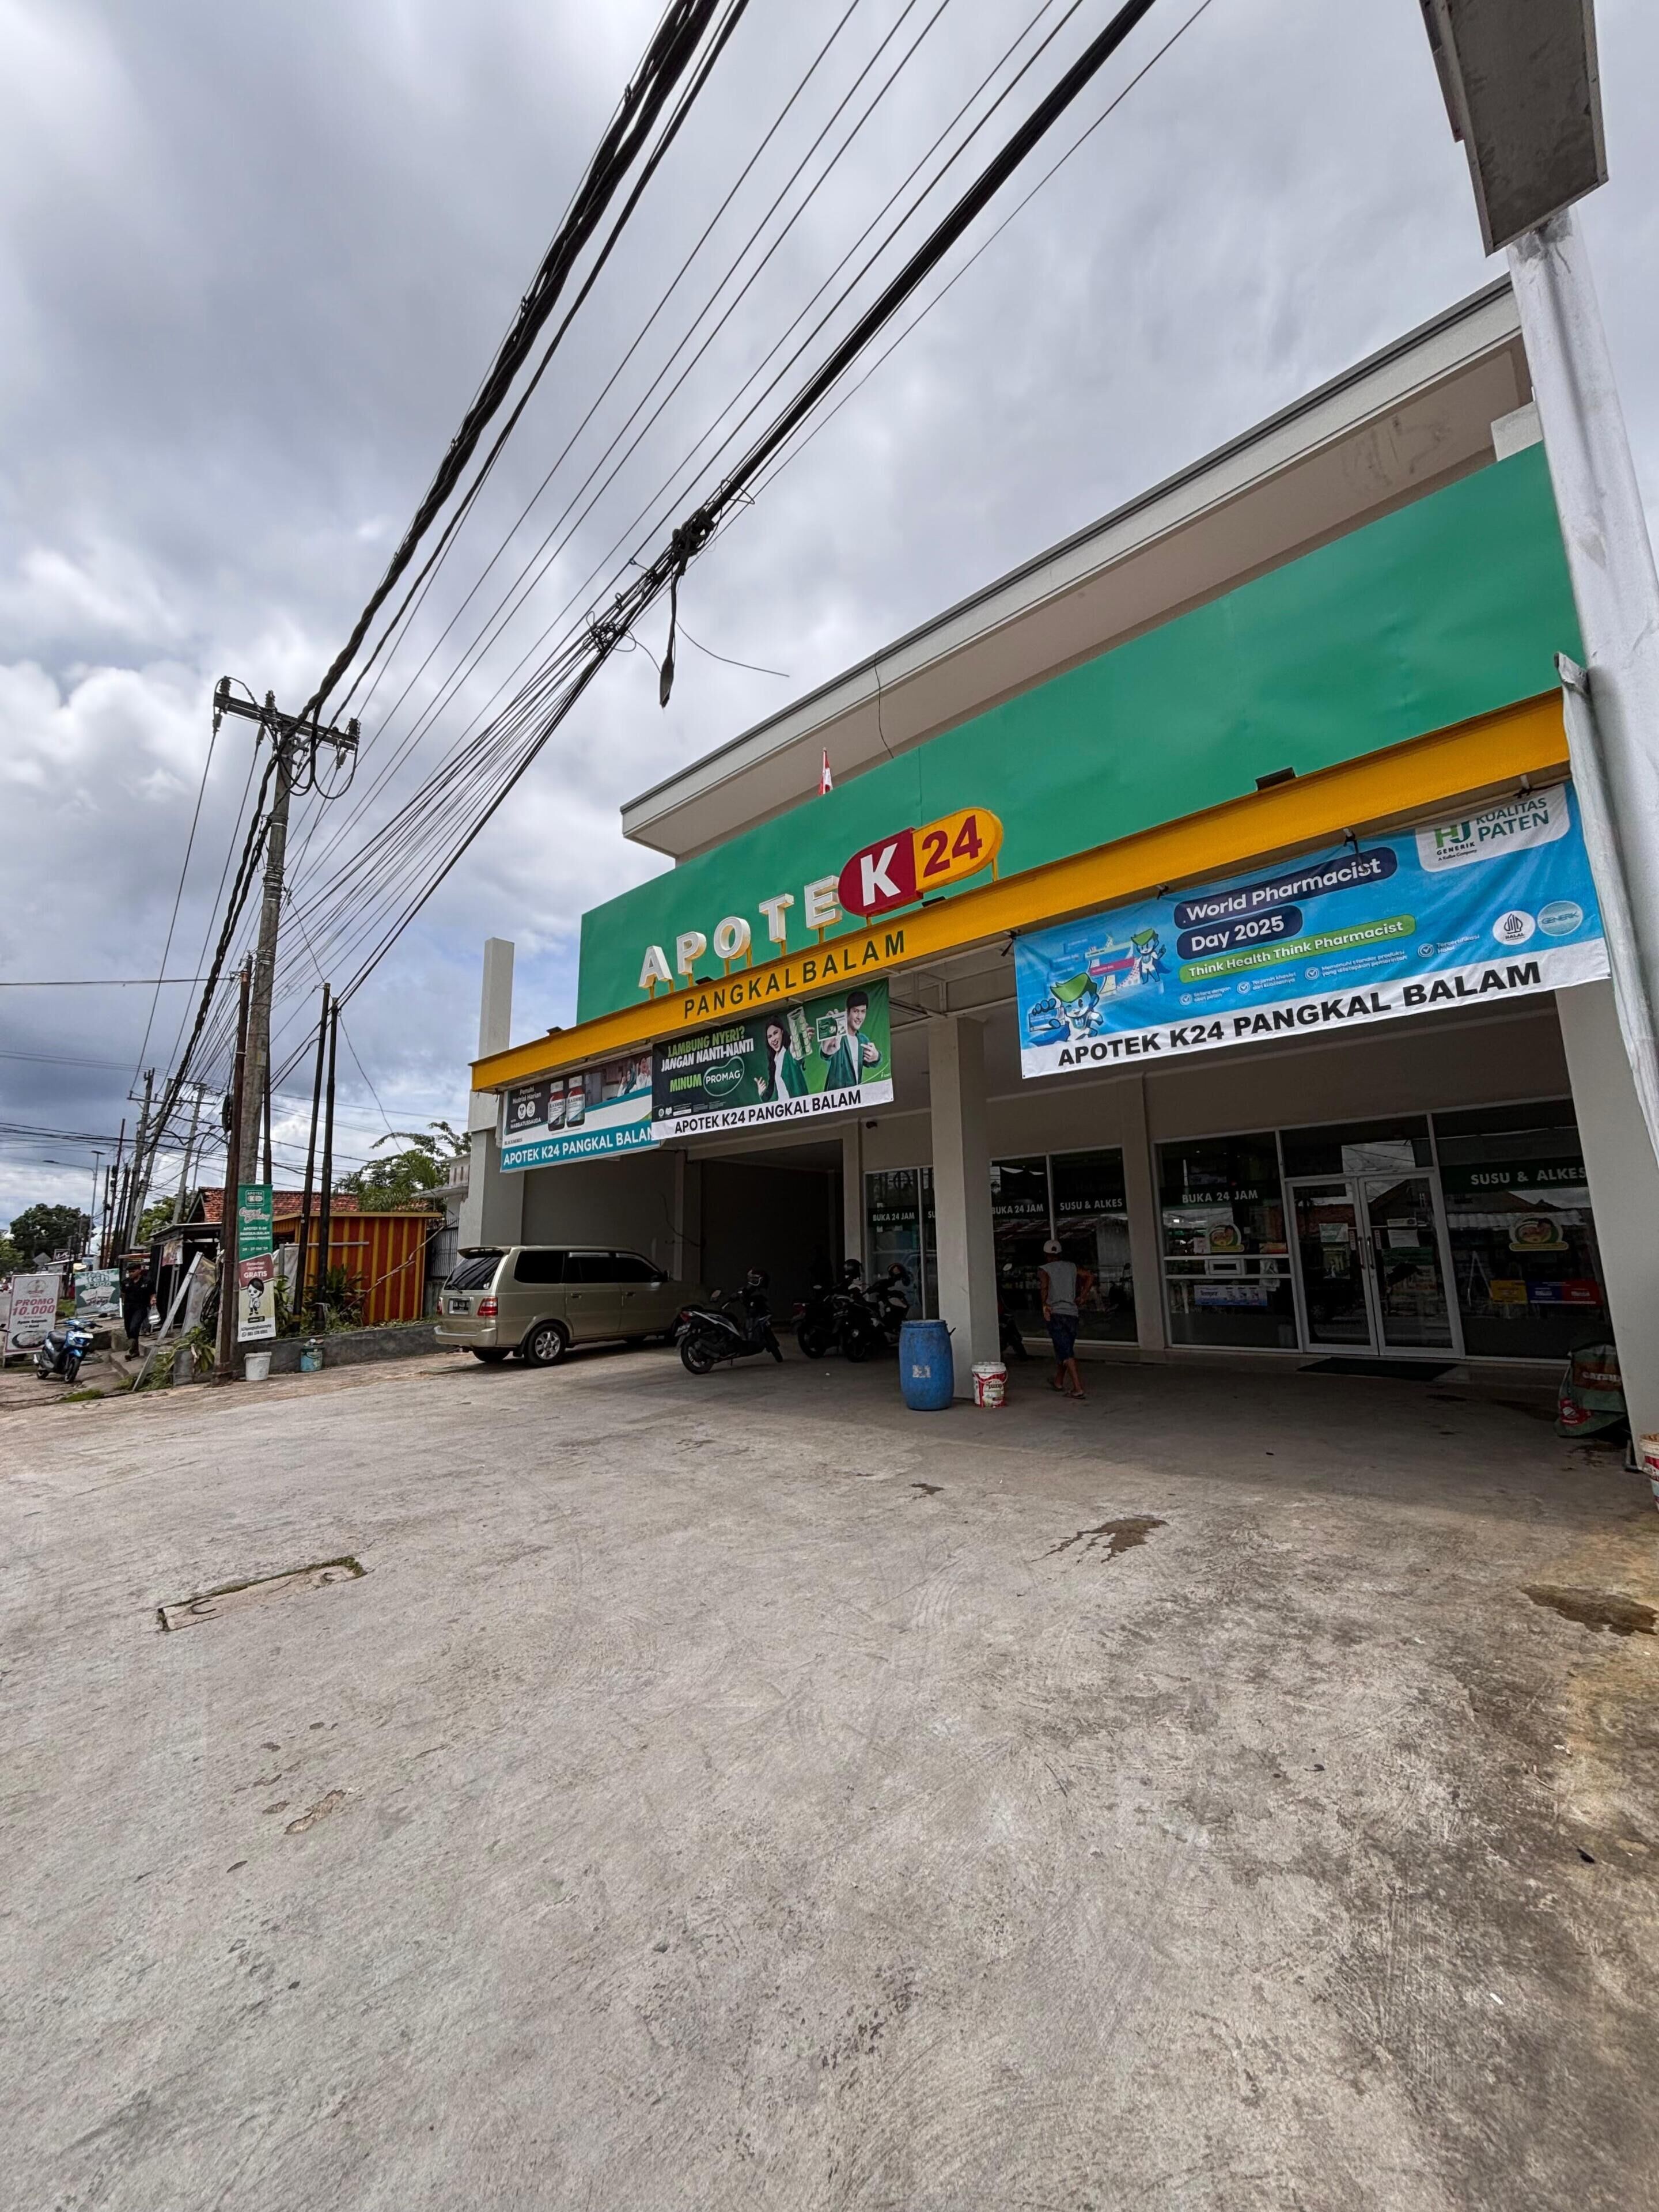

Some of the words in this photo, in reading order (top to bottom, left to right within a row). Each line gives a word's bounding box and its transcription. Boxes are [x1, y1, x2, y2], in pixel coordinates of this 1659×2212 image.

[1476, 798, 1547, 825] KUALITAS
[1478, 810, 1549, 842] PATEN
[1437, 842, 1475, 855] GENERIK
[1186, 894, 1247, 921] World
[1252, 858, 1381, 906] Pharmacist
[1541, 911, 1579, 925] GENERIK
[1191, 930, 1230, 952] Day
[1234, 915, 1285, 941] 2025
[1189, 961, 1224, 977] Think
[1227, 952, 1270, 969] Health
[1274, 941, 1311, 959] Think
[1315, 921, 1403, 950] Pharmacist
[1058, 1033, 1160, 1066] APOTEK
[1169, 1021, 1224, 1049] K24
[1234, 993, 1391, 1037] PANGKAL
[1402, 961, 1540, 1008] BALAM
[668, 1035, 710, 1058] LAMBUNG
[712, 1025, 745, 1046] NYERI?
[661, 1052, 695, 1072] JANGAN
[696, 1037, 754, 1063] NANTI-NANTI
[669, 1073, 702, 1093] MINUM
[706, 1070, 741, 1085] PROMAG
[675, 1114, 719, 1134] APOTEK
[722, 1110, 745, 1126] K24
[748, 1100, 809, 1122] PANGKAL
[812, 1089, 861, 1112] BALAM
[504, 1148, 539, 1166] APOTEK
[541, 1143, 559, 1159] K24
[562, 1134, 613, 1155] PANGKAL
[1471, 1172, 1510, 1185] SUSU
[1517, 1171, 1529, 1182] &
[1537, 1167, 1586, 1181] ALKES
[1014, 1205, 1024, 1213] 24
[1027, 1203, 1044, 1213] JAM
[1060, 1201, 1082, 1211] SUSU
[1085, 1200, 1091, 1209] &
[1094, 1198, 1123, 1209] ALKES
[1182, 1192, 1212, 1203] BUKA
[1217, 1191, 1230, 1201] 24
[1234, 1190, 1258, 1200] JAM
[892, 1213, 899, 1221] 24
[901, 1212, 915, 1220] JAM
[13, 1305, 55, 1316] 10.000
[15, 1298, 54, 1306] PROMO
